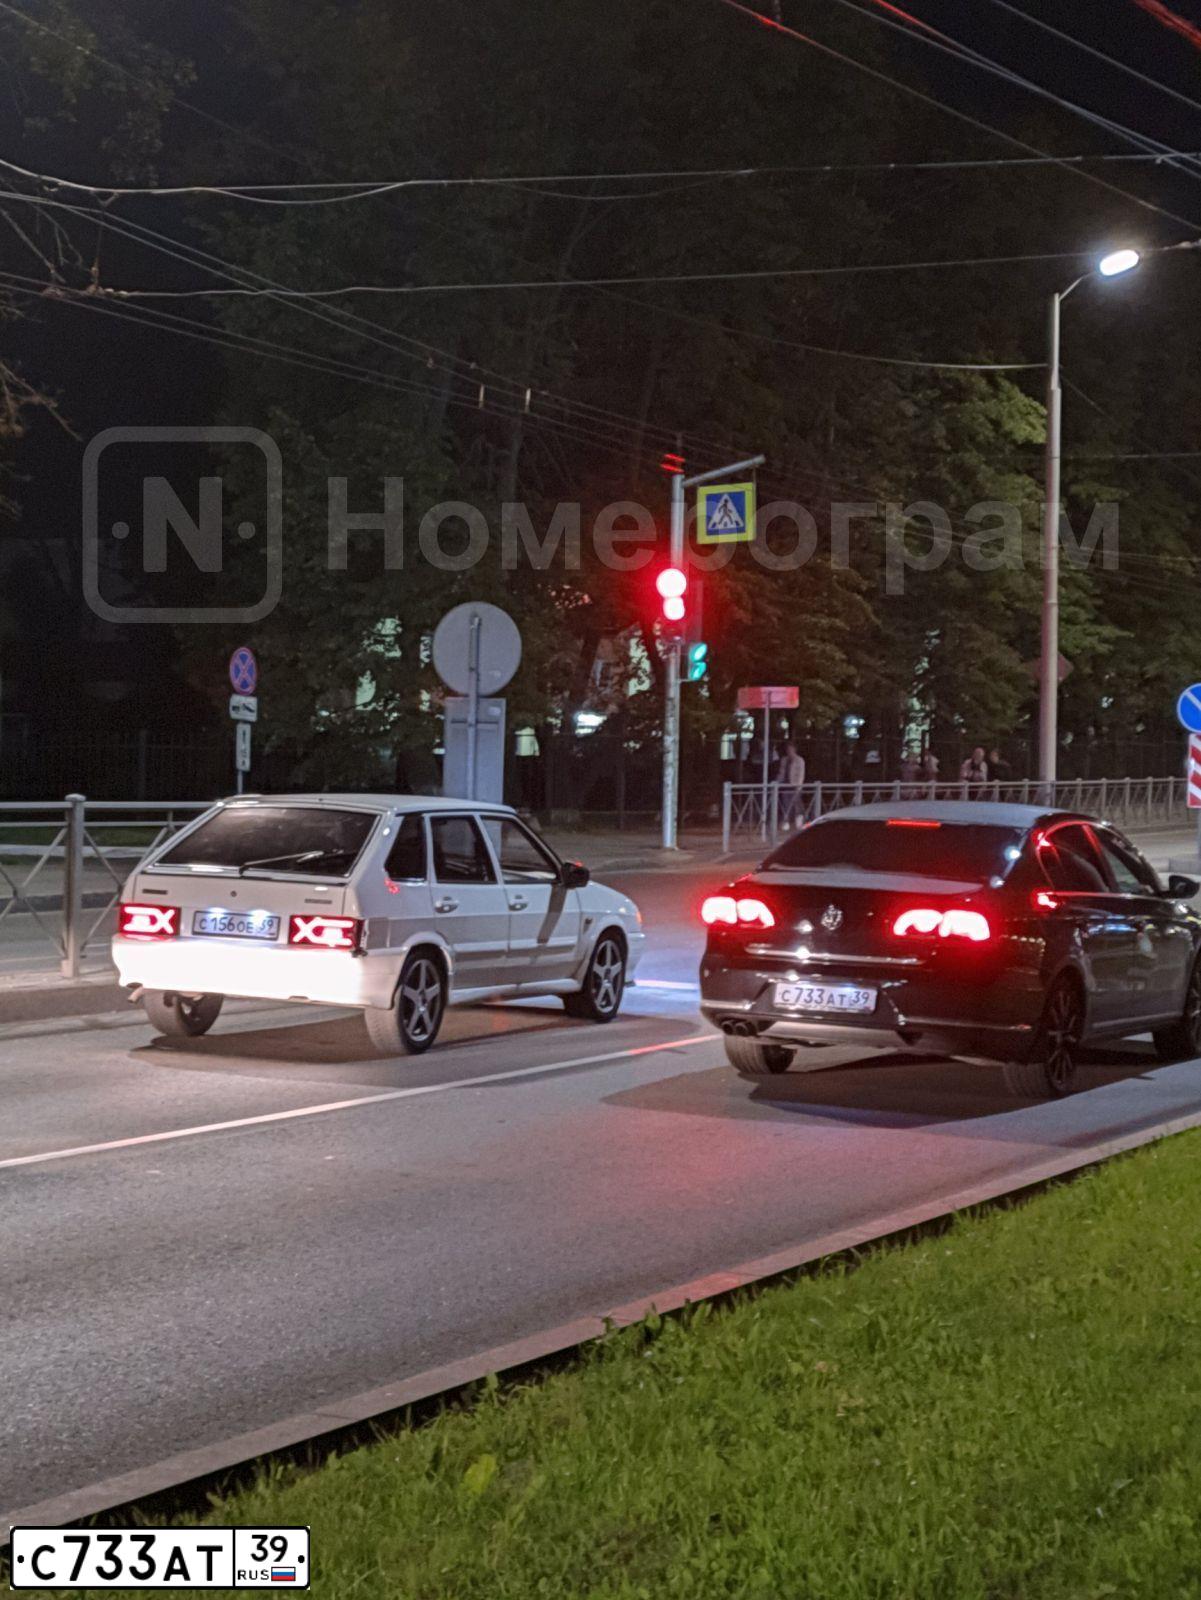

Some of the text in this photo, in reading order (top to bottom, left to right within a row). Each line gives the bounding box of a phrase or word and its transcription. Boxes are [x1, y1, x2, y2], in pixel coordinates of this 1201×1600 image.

[199, 916, 254, 933] С156ОЕ
[781, 987, 870, 1006] С733АТ 39
